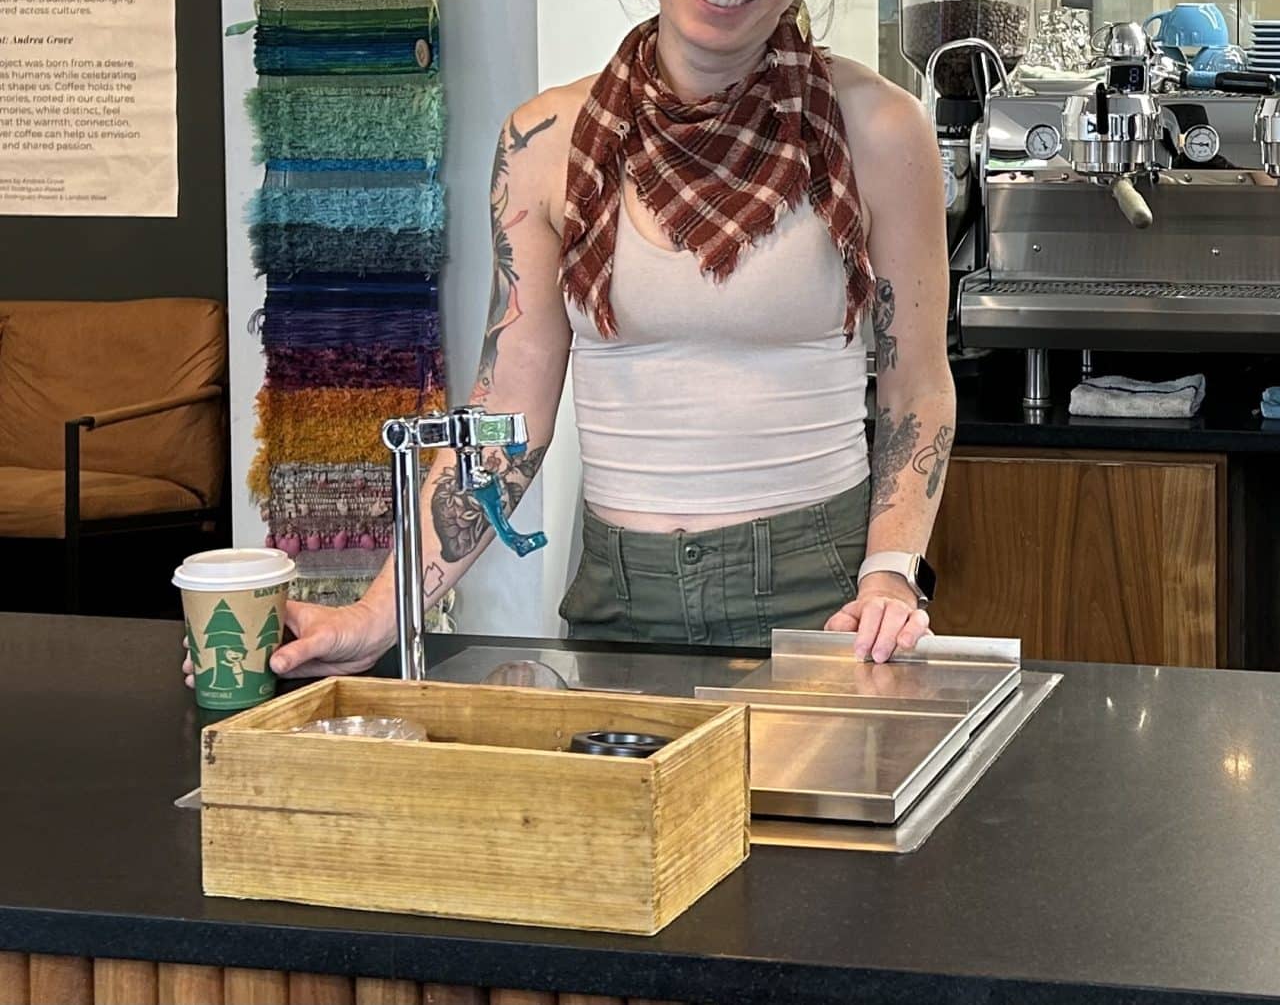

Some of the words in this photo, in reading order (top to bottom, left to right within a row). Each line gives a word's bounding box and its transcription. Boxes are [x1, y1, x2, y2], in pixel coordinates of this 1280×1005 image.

[19, 7, 49, 15] across
[12, 35, 44, 45] Andrea
[104, 58, 135, 68] desire
[12, 71, 52, 79] humans
[53, 71, 80, 79] while
[81, 70, 137, 81] celebrating
[7, 83, 37, 92] shape
[54, 82, 86, 91] Coffee
[88, 83, 114, 91] holds
[32, 94, 64, 103] rooted
[95, 94, 136, 104] cultures
[35, 106, 61, 115] while
[14, 130, 43, 138] coffee
[100, 130, 141, 139] envision
[22, 141, 55, 150] shared
